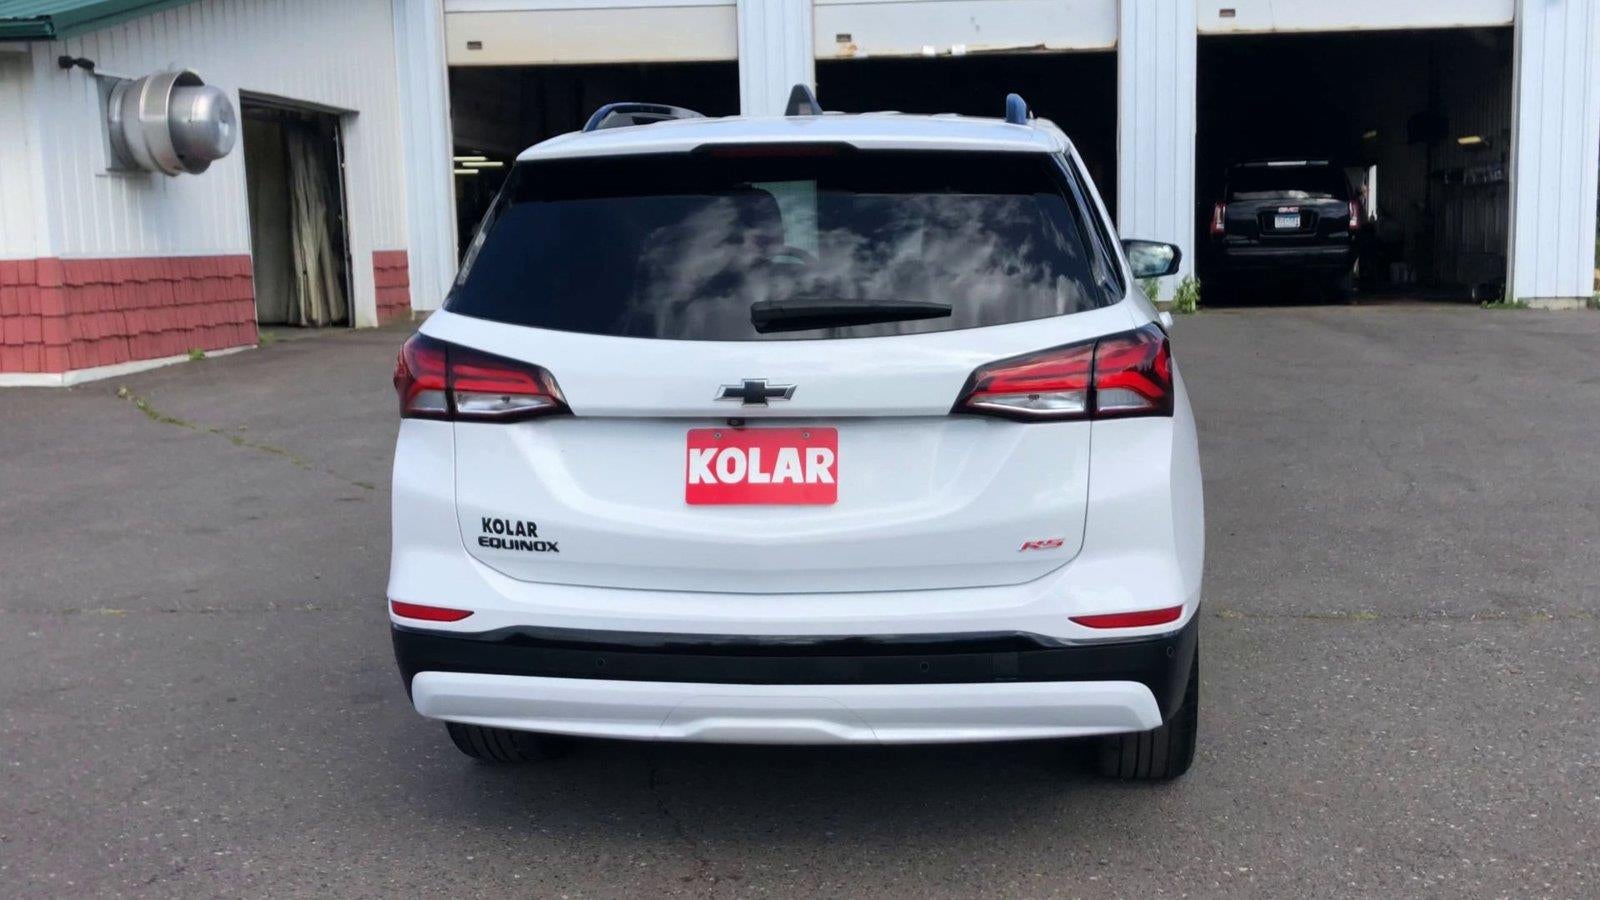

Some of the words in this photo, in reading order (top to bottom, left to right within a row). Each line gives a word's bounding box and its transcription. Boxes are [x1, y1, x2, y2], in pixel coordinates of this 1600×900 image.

[688, 447, 835, 484] KOLAR
[481, 517, 538, 537] KOLAR
[478, 536, 560, 552] EQUINOX
[1019, 538, 1065, 551] RS
